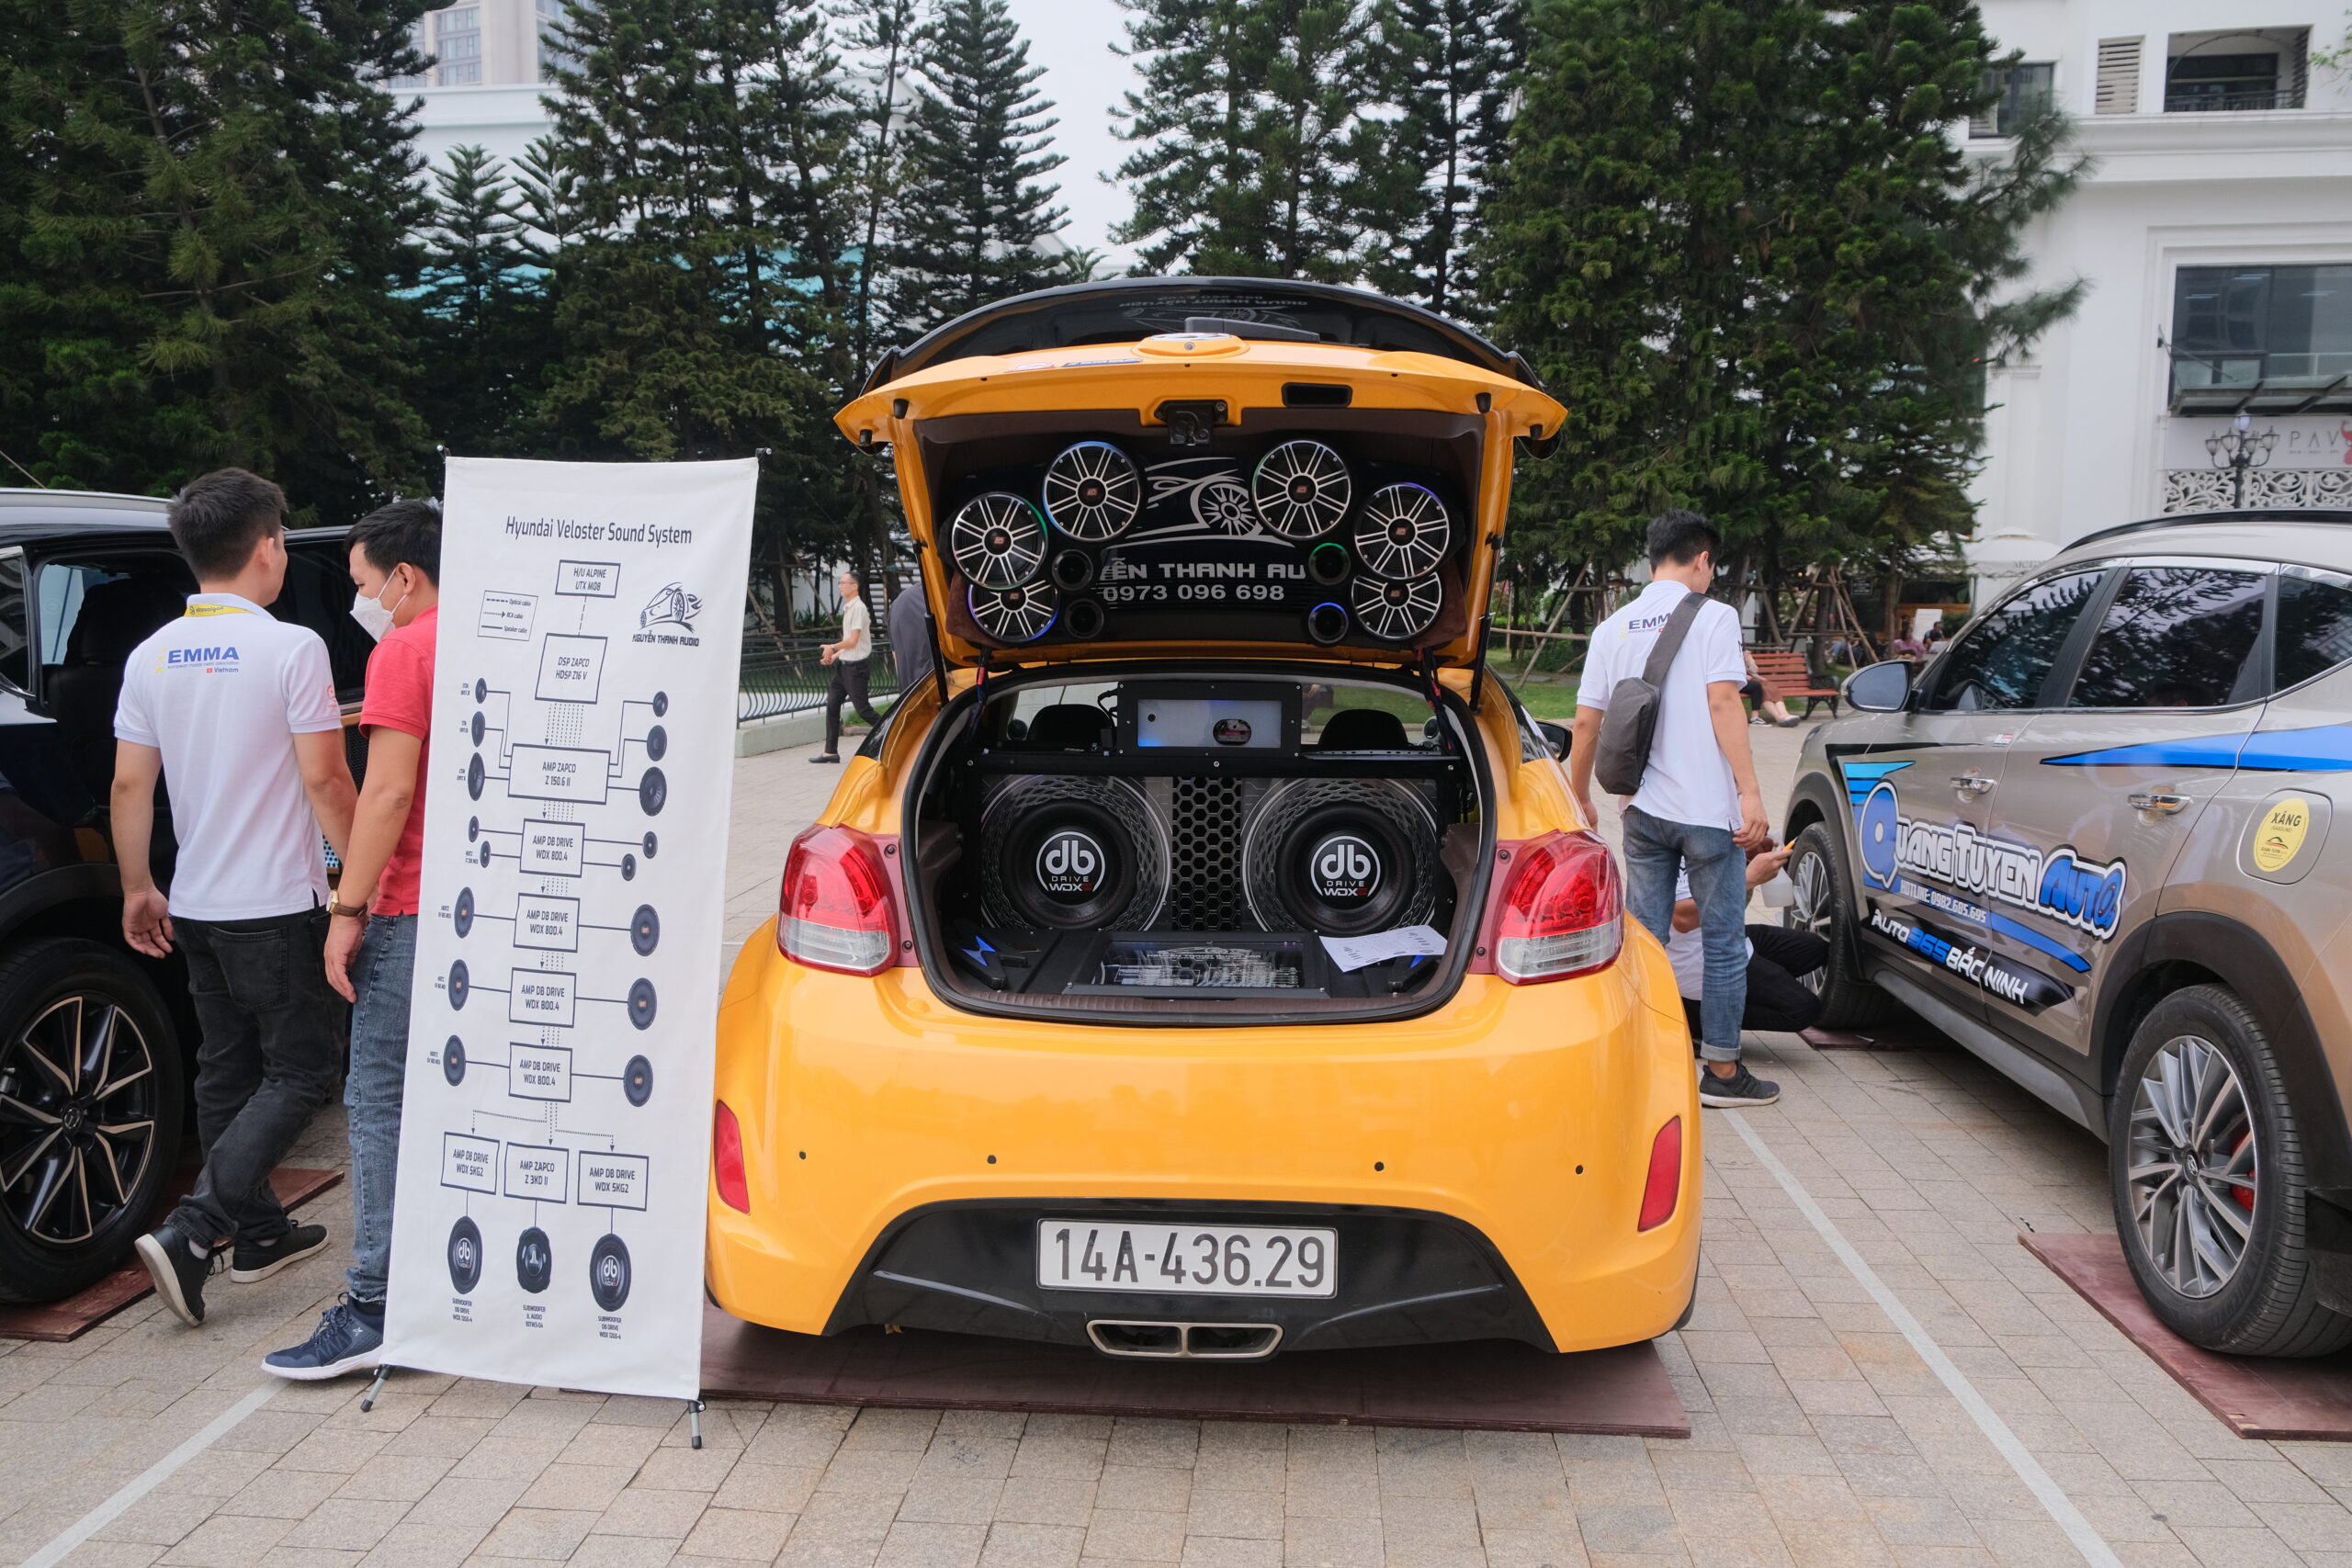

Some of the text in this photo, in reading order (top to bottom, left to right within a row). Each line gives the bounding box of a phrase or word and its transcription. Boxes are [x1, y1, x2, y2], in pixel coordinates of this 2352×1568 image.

[505, 516, 692, 547] Hyundai Veloster Sound System
[585, 569, 606, 579] ALPINE
[1158, 563, 1255, 579] THANH
[575, 581, 586, 590] UTX
[1102, 584, 1284, 601] 0973 096 698
[1629, 613, 1672, 630] EMM
[658, 634, 678, 645] THANH
[680, 636, 699, 647] AUDIO
[168, 647, 239, 663] EMMA
[558, 656, 590, 667] DSP ZAPCO
[555, 670, 571, 680] HDSP
[542, 761, 577, 773] AMP ZAPCO
[546, 775, 549, 785] Z
[533, 835, 573, 847] AMP DB DRIVE
[1861, 782, 1953, 888] QUANG
[1955, 831, 2039, 902] TUYEN
[537, 849, 568, 861] WDX 800.4
[1900, 879, 1987, 923] HOTLINE: 0982.685.695
[526, 909, 568, 922] AMP DB DRIVE
[529, 924, 562, 936] WDX 800.4
[1984, 965, 2030, 1005] NINH
[522, 985, 564, 998] AMP DB DRIVE
[526, 999, 559, 1010] WDX 800.4
[520, 1060, 560, 1073] AMP DB DRIVE
[524, 1074, 555, 1086] WDX 800.4
[453, 1148, 489, 1164] AMP DB DRIVE
[456, 1165, 483, 1177] WDX 5KG2
[520, 1160, 555, 1172] AMP ZAPCO
[526, 1176, 529, 1184] Z
[590, 1168, 636, 1180] AMP DB DRIVE
[595, 1181, 628, 1193] WDX 5KG2
[1056, 1228, 1325, 1288] 14A-436.29
